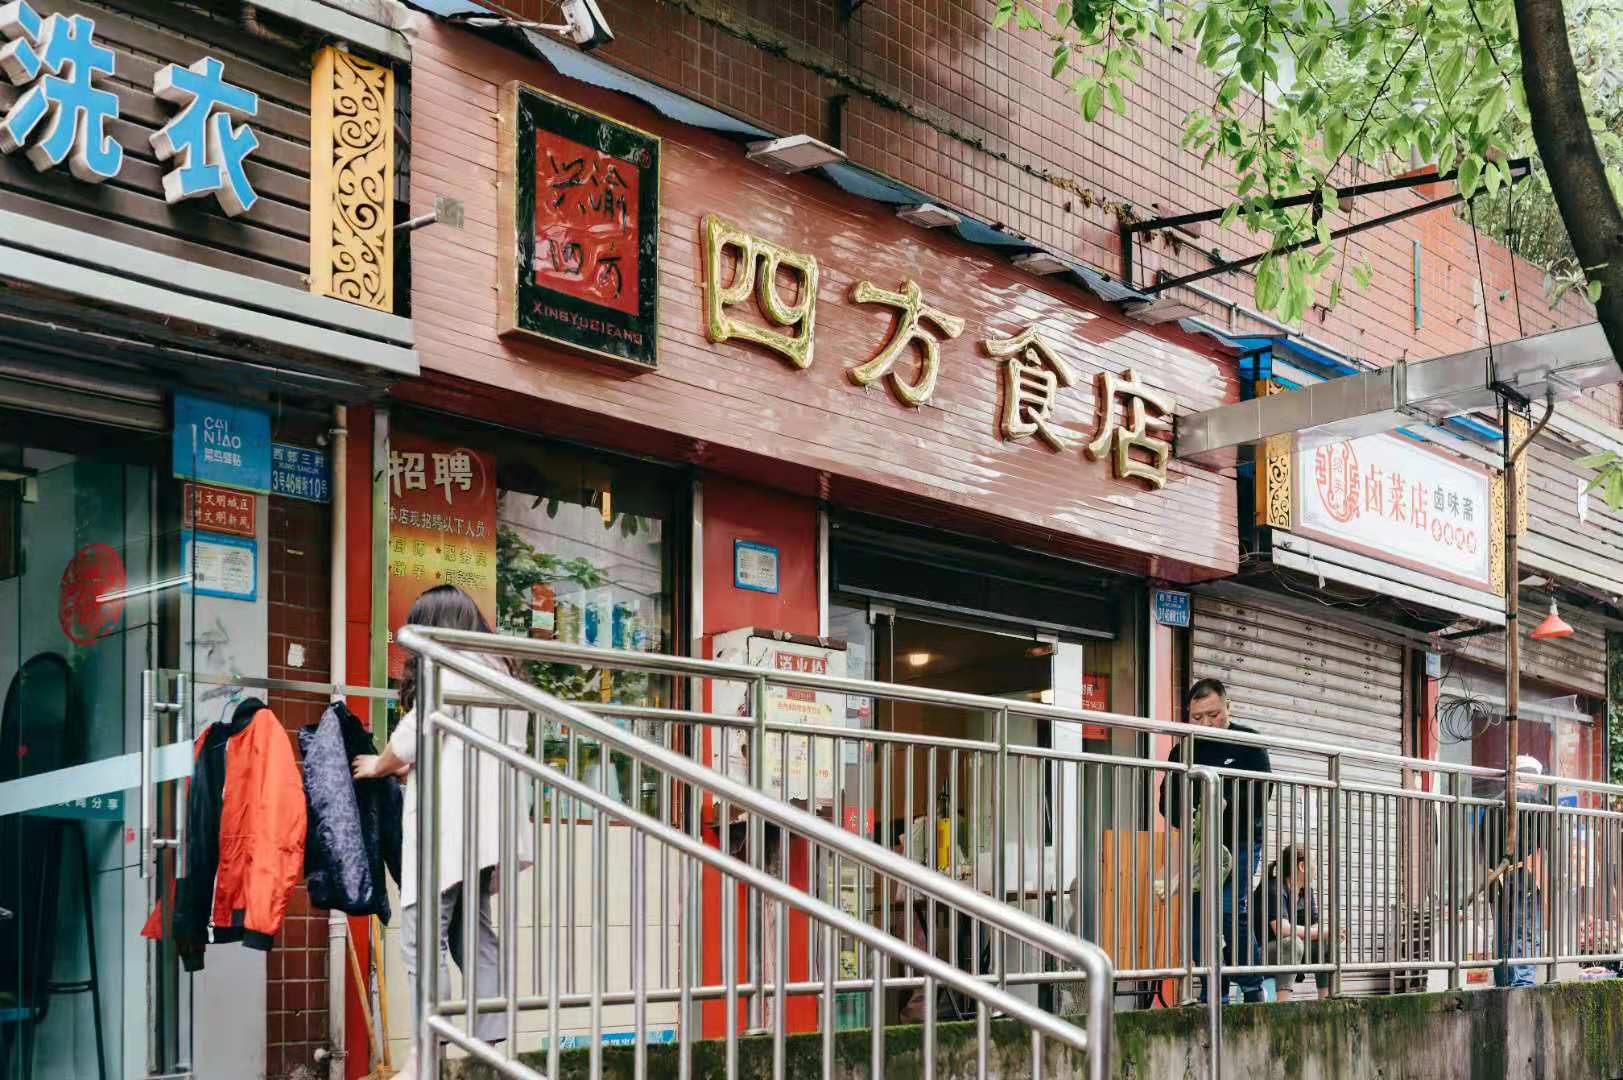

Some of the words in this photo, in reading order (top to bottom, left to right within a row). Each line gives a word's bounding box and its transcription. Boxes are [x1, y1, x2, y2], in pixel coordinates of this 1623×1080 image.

[0, 0, 260, 217] 洗衣
[700, 213, 1177, 490] 四方食店
[204, 416, 228, 432] CAI
[204, 429, 242, 449] NIAO
[389, 451, 473, 505] 招聘
[1364, 463, 1428, 530] 卤菜店
[1432, 484, 1475, 522] 卤味斋
